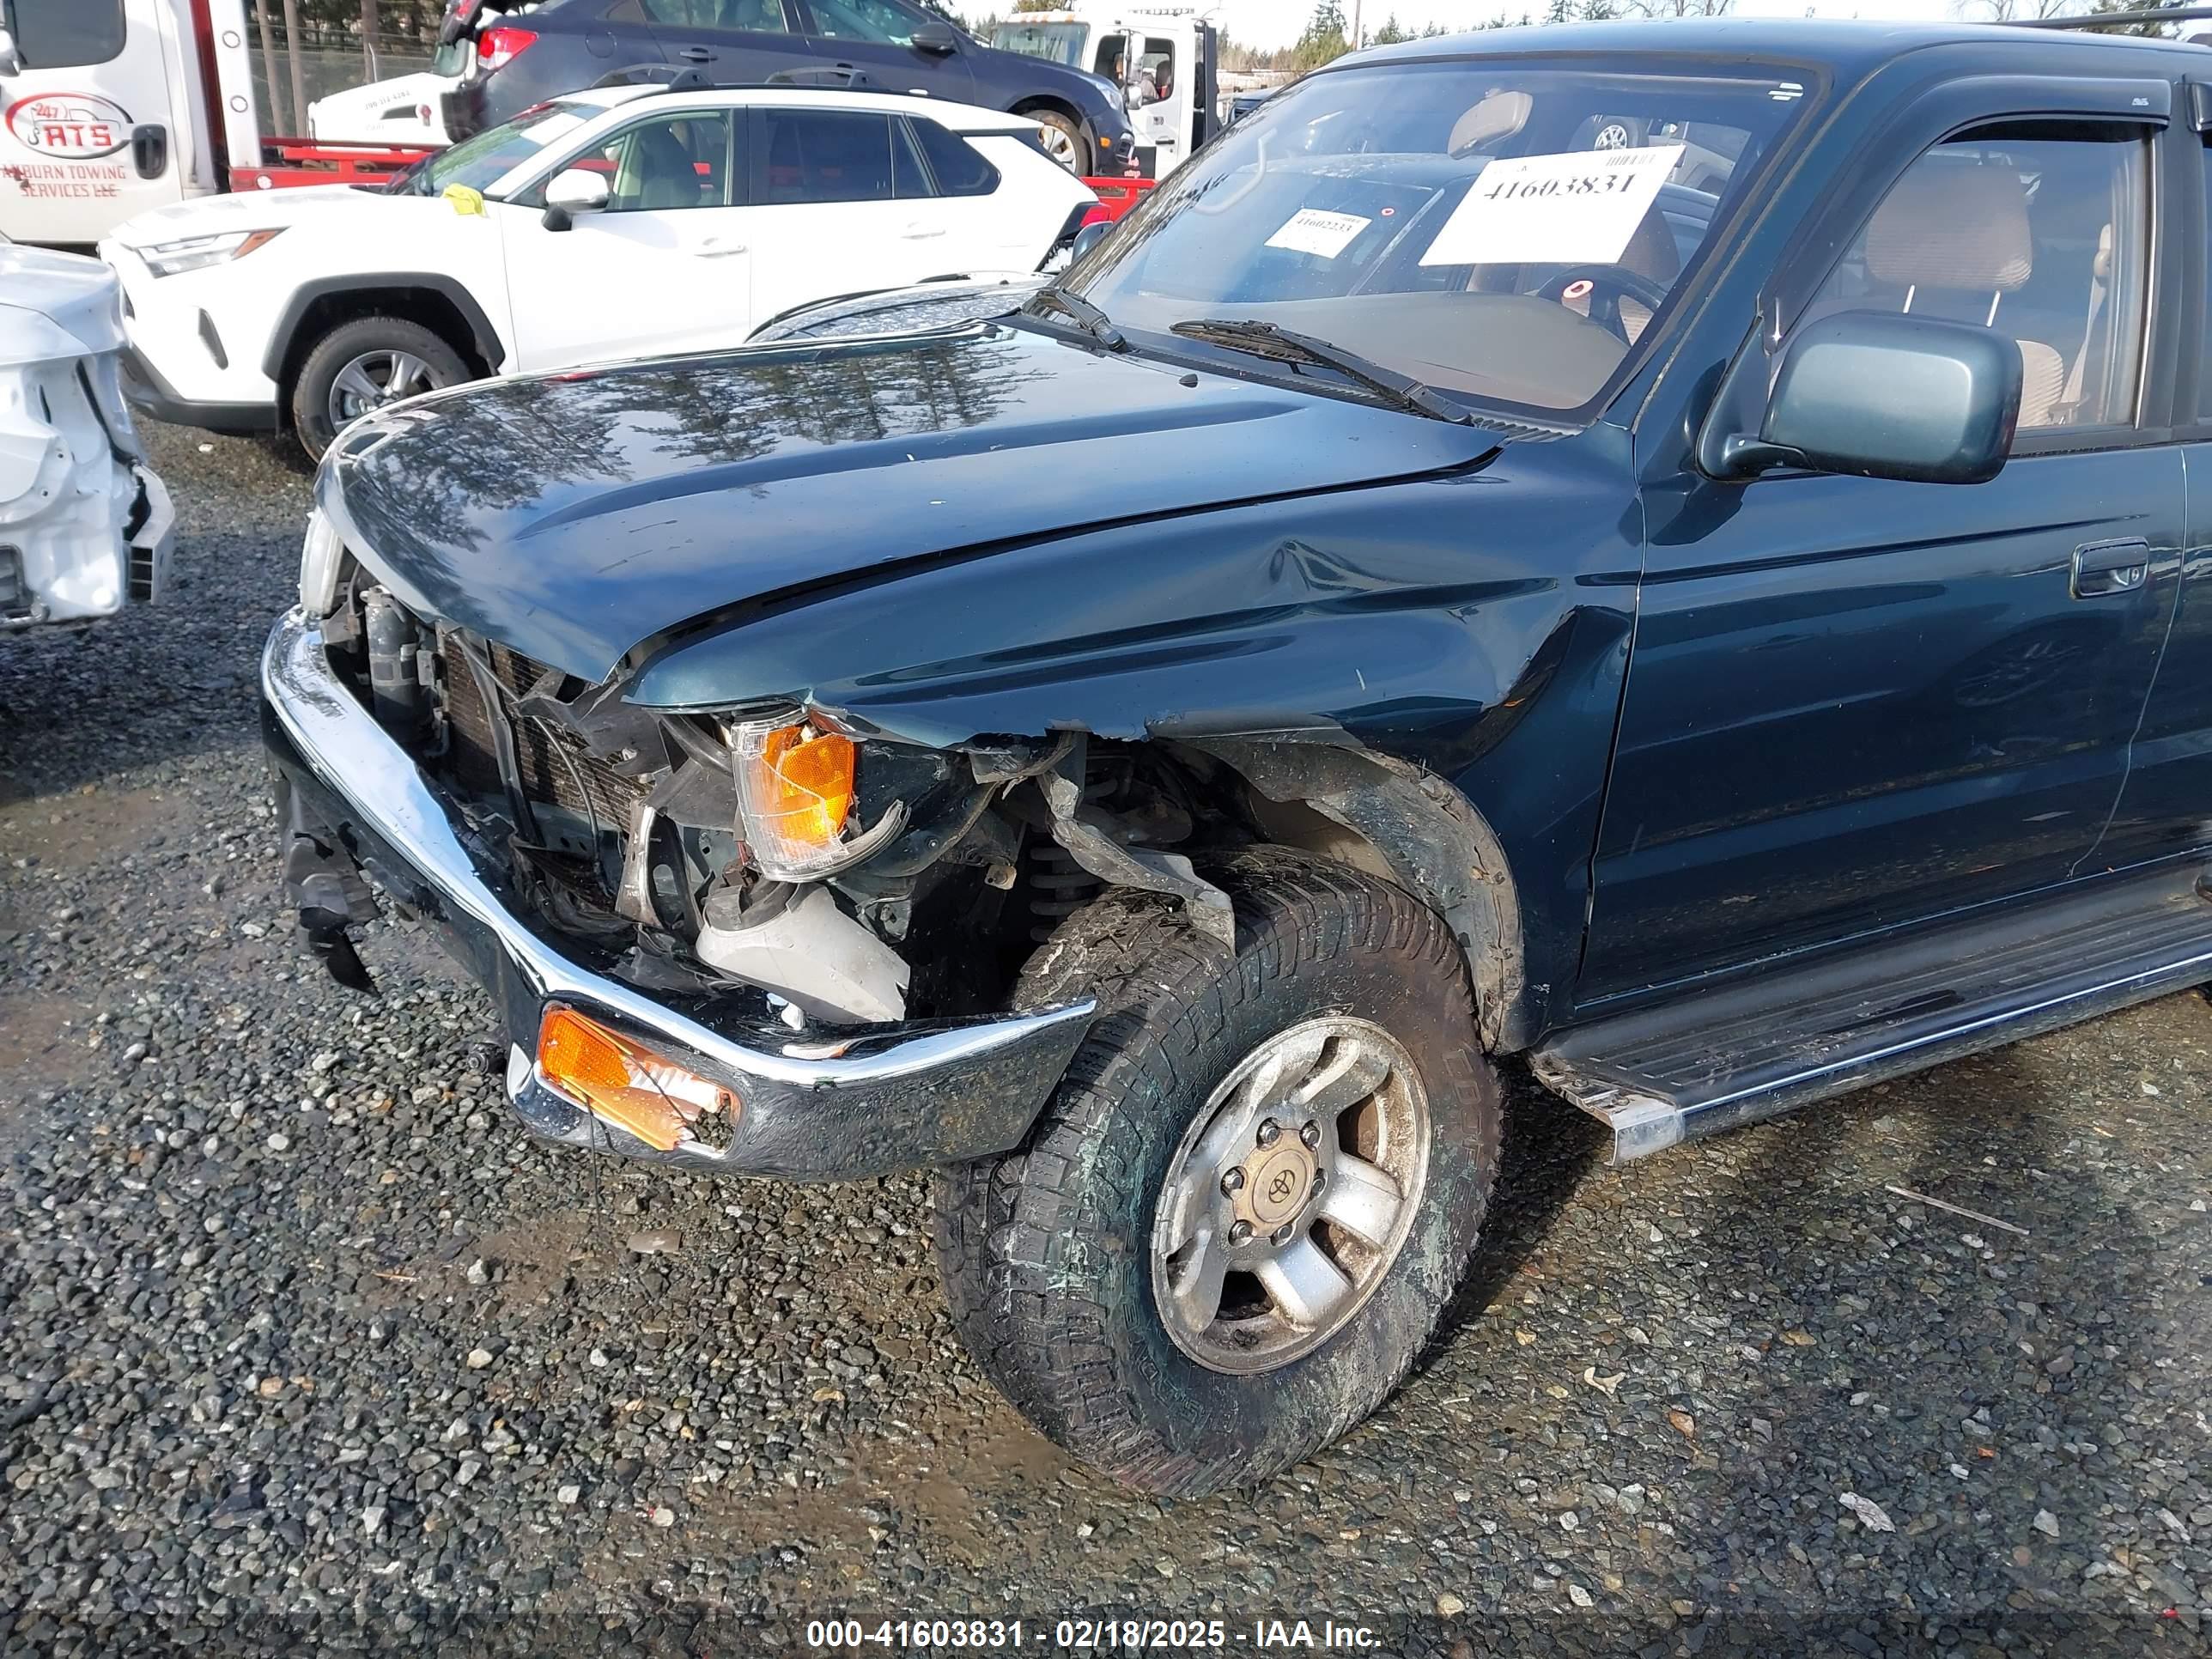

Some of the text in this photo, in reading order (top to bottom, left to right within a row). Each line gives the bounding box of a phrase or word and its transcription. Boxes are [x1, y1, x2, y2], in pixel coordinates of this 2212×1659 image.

[36, 103, 59, 118] 247
[44, 124, 112, 147] ATS
[68, 165, 126, 179] TOWING
[20, 183, 89, 198] SERVICES
[1484, 173, 1636, 199] 41603831
